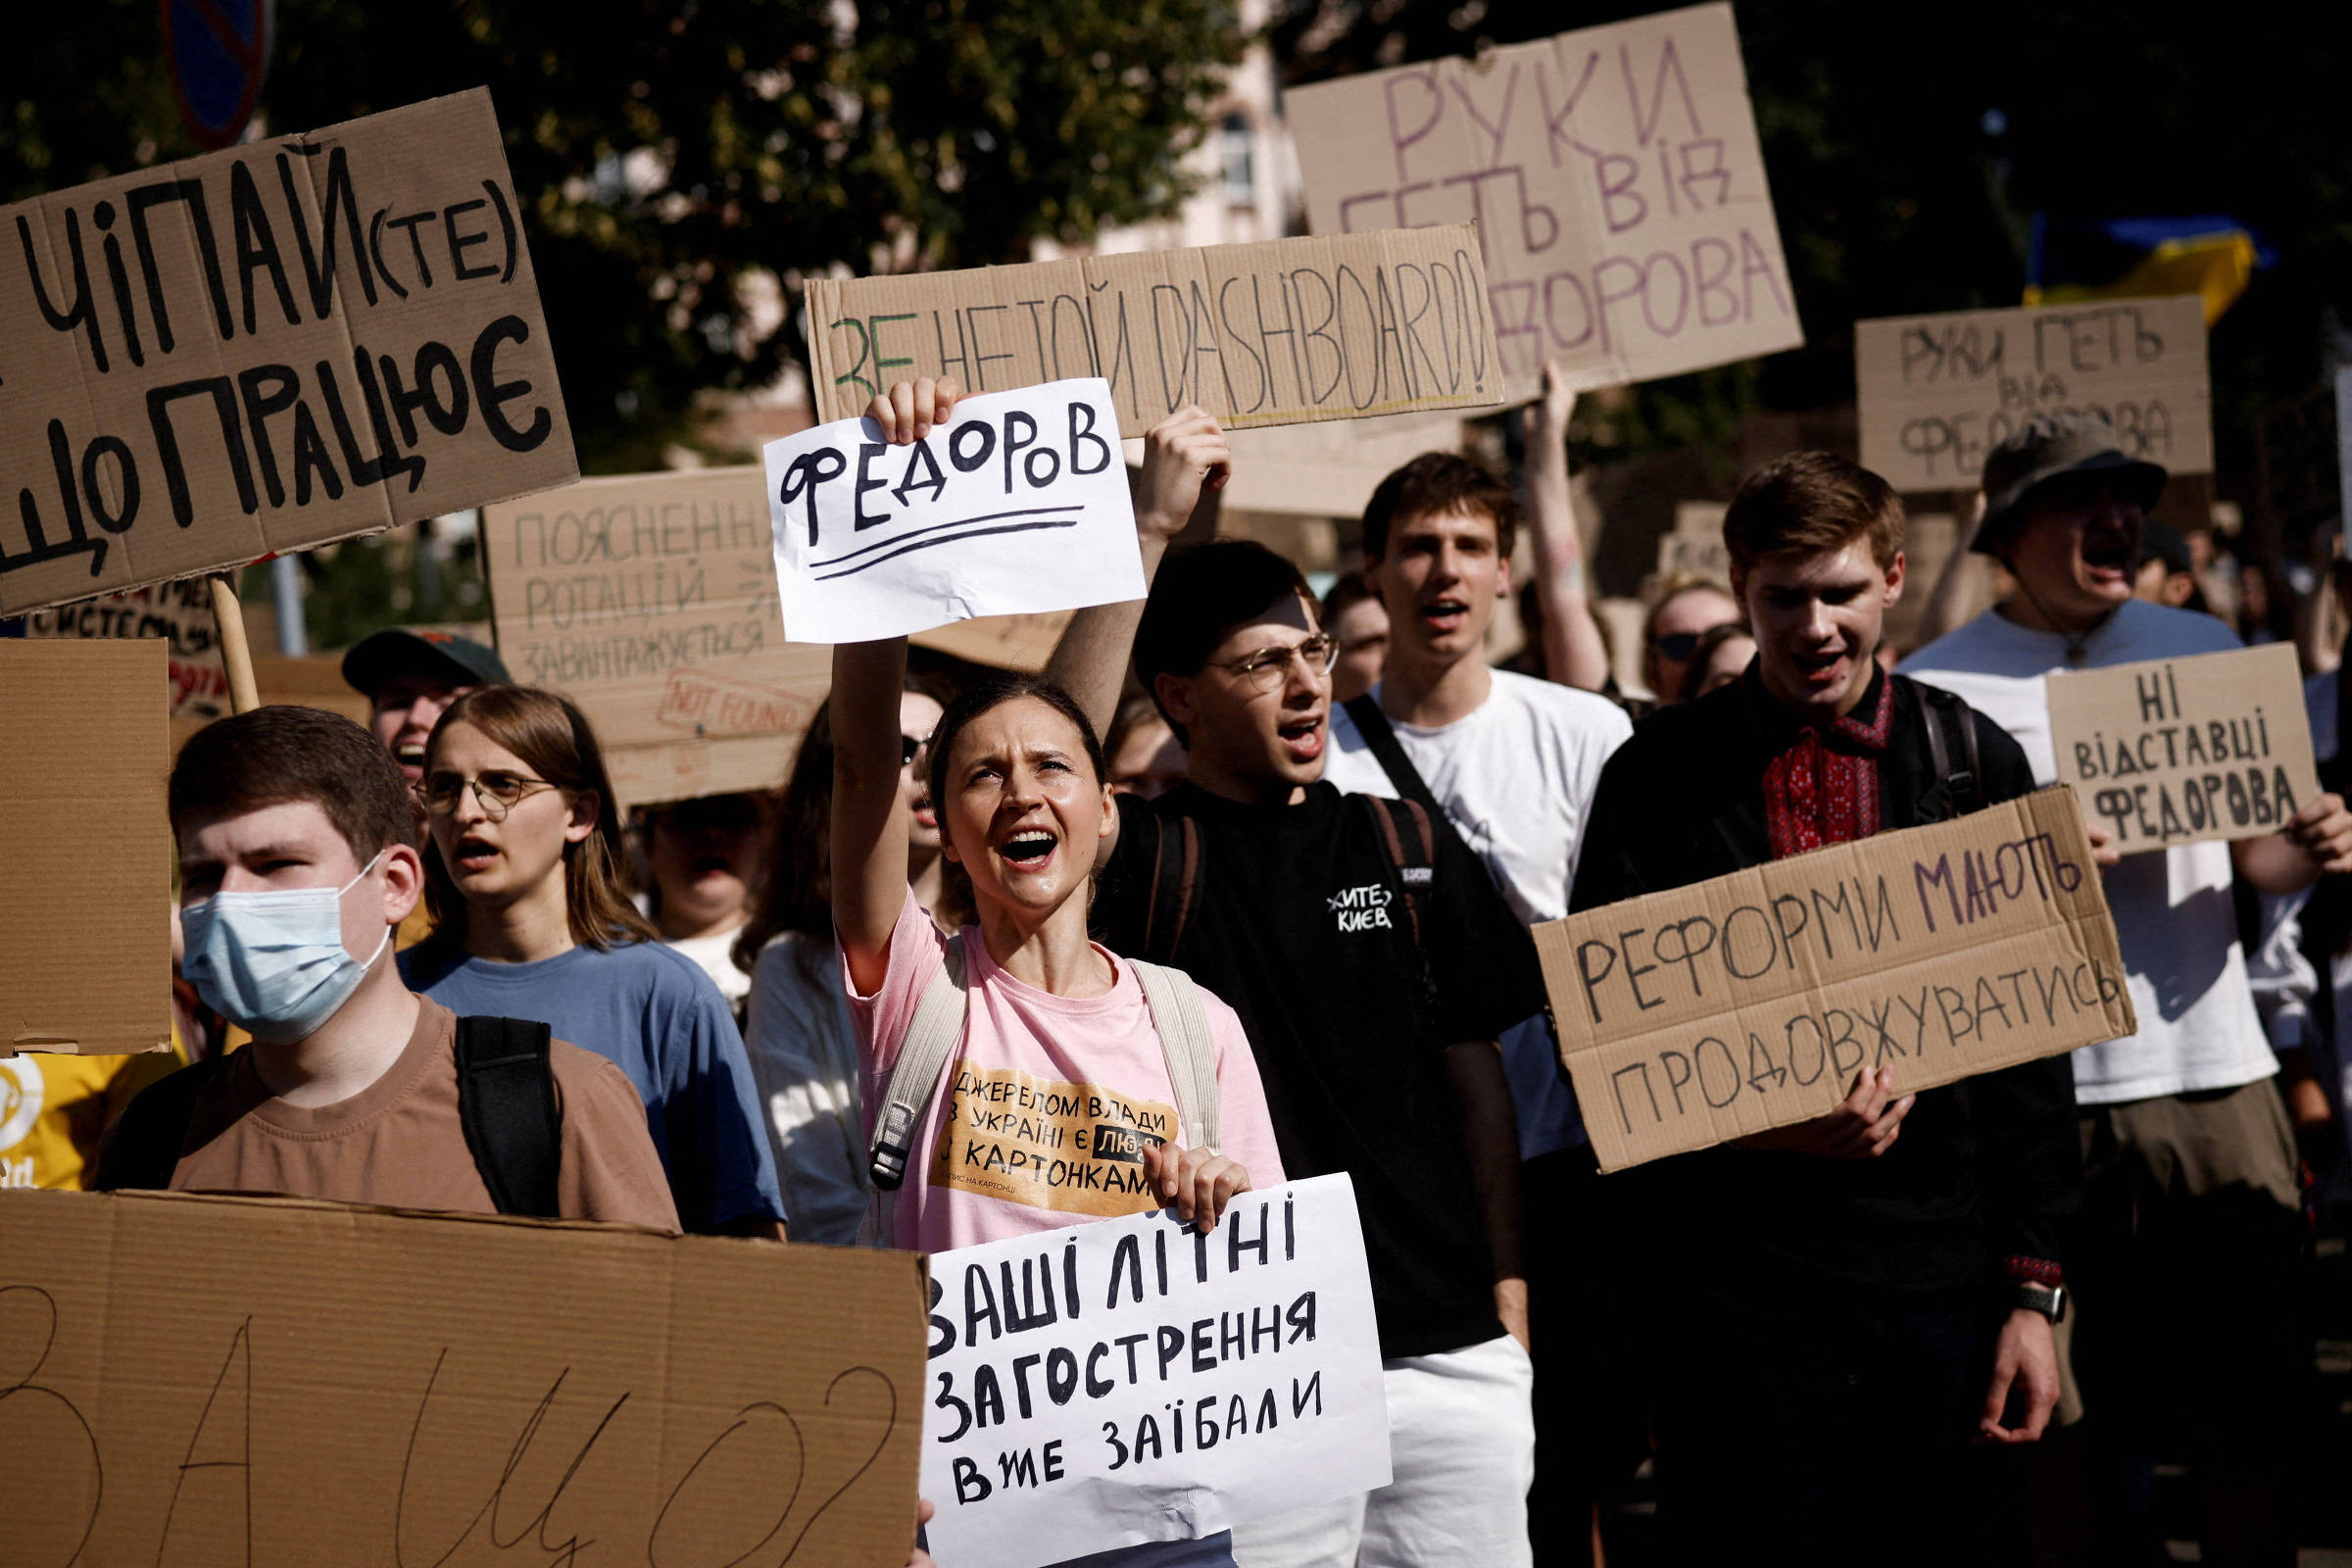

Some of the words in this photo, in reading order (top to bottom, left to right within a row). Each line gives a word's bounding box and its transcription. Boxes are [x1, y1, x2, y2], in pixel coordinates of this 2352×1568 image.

[1383, 35, 1703, 183] РУКИ
[1596, 137, 1733, 233] ВІД
[1016, 280, 1139, 421] ТОЙ
[1487, 227, 1791, 379] ДОРОВА
[1899, 323, 2006, 386] РУКИ
[2034, 306, 2165, 374] ГЕТЬ
[145, 314, 553, 529] ПРАЦЮЄ
[779, 402, 1111, 547] ФЕДОРОВ
[514, 501, 759, 568] ПОЯСНЕНН
[526, 559, 706, 632] РОТАЦІЙ
[2136, 663, 2180, 722] НІ
[2073, 705, 2271, 780] ВІДСТАВЦІ
[2094, 764, 2298, 842] ФЕДОРОВА
[1576, 874, 1901, 1024] РЕФОРМИ
[1913, 833, 2082, 933] МАЮТЬ
[1611, 958, 2120, 1135] ПРОДОВЖУВАТИСЬ
[953, 1071, 1081, 1118] ДЖЕРЕЛОМ
[1088, 1096, 1165, 1133] ВЛАДИ
[970, 1106, 1064, 1149] УКРАЇНІ
[1074, 1128, 1088, 1150] Є
[964, 1138, 1151, 1197] КАРТОНКАМ
[966, 1176, 977, 1185] НА
[978, 1178, 1016, 1194] КАРТОНЦІ
[1105, 1190, 1295, 1310] ЛІТНІ
[936, 1290, 1317, 1444] ЗАГОСТРЕННЯ
[953, 1439, 1065, 1505] ВЖЕ
[1102, 1370, 1323, 1471] ЗАЇБАЛИ
